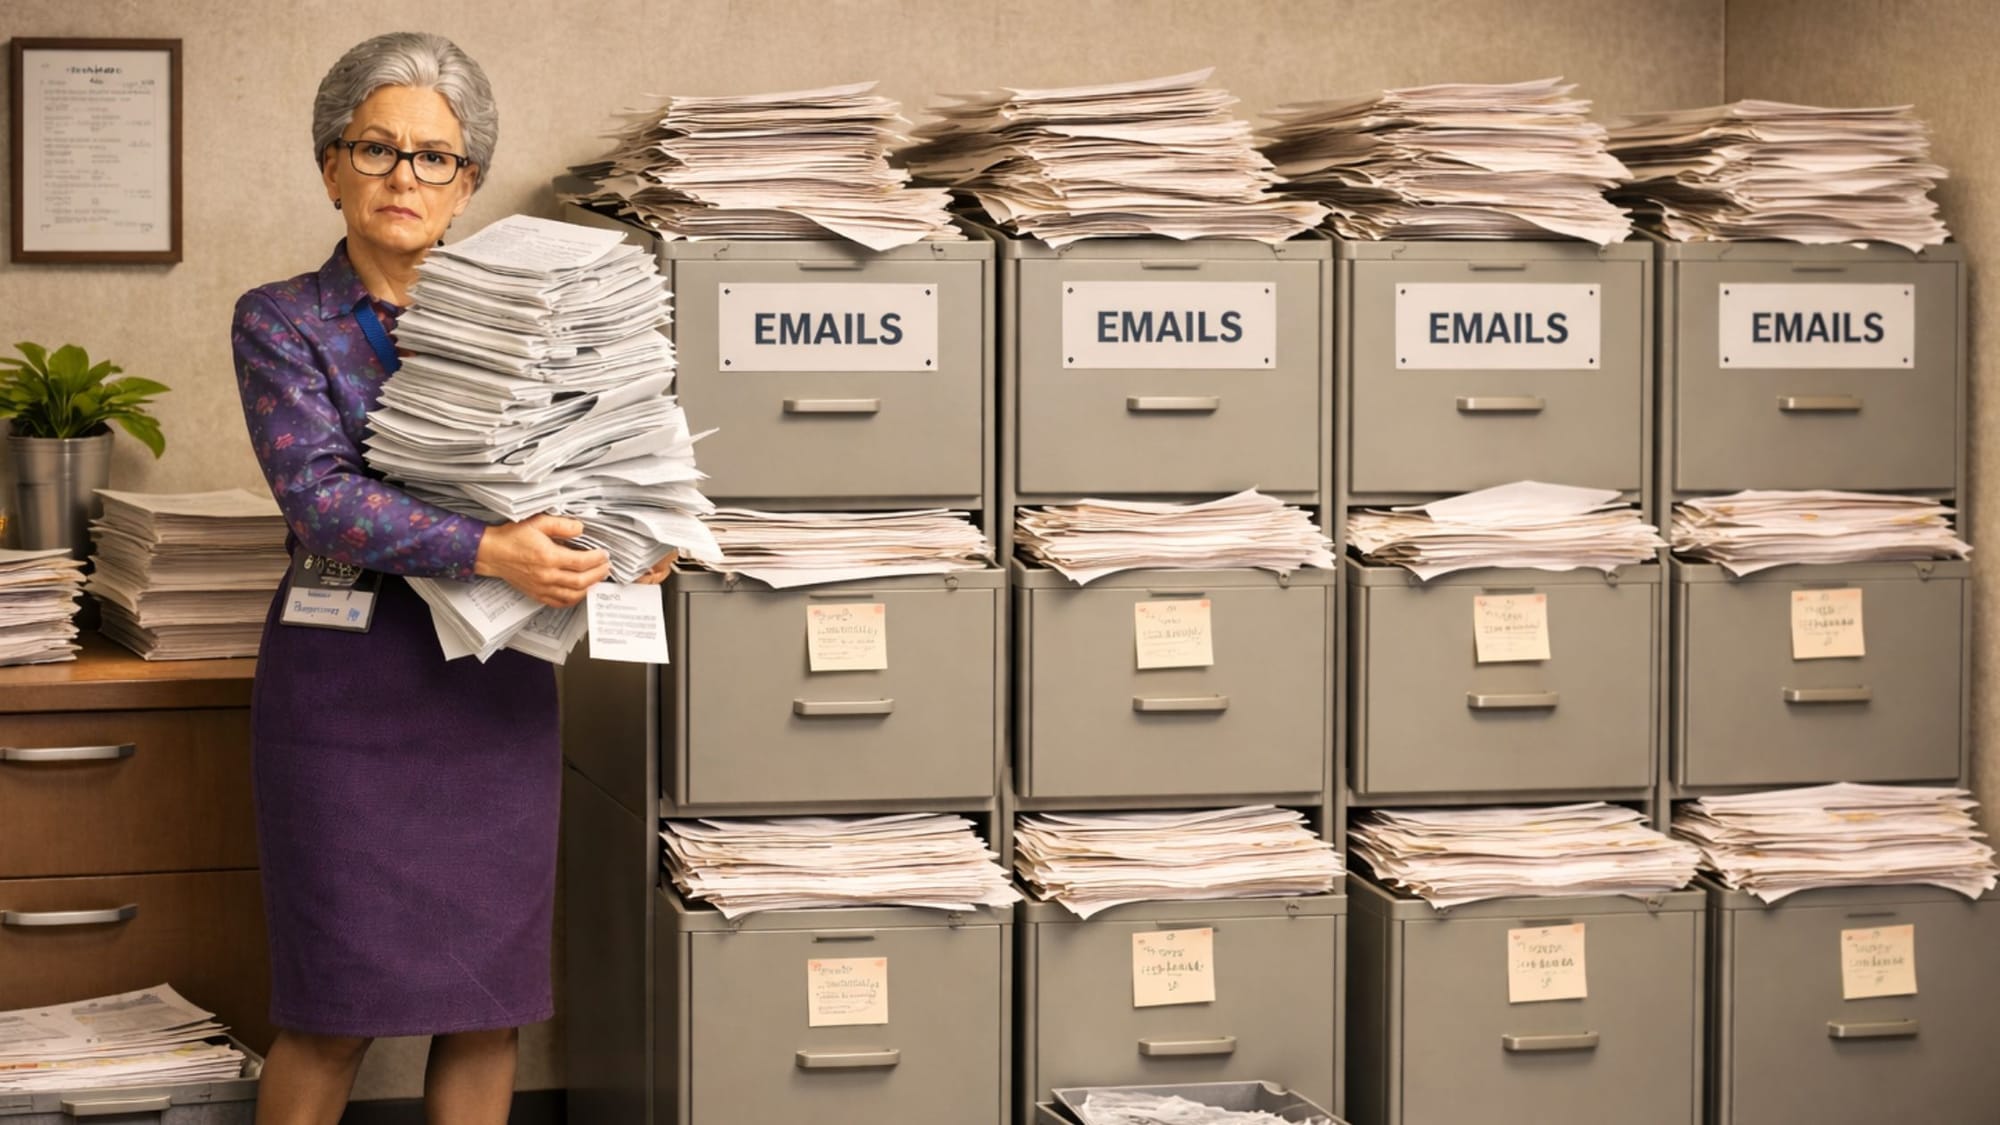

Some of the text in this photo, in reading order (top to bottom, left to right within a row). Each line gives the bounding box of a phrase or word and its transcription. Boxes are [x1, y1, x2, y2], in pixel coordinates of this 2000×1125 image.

[756, 312, 903, 345] EMAILS
[1098, 311, 1243, 343] EMAILS
[1429, 312, 1569, 344] EMAILS
[1752, 312, 1885, 344] EMAILS
